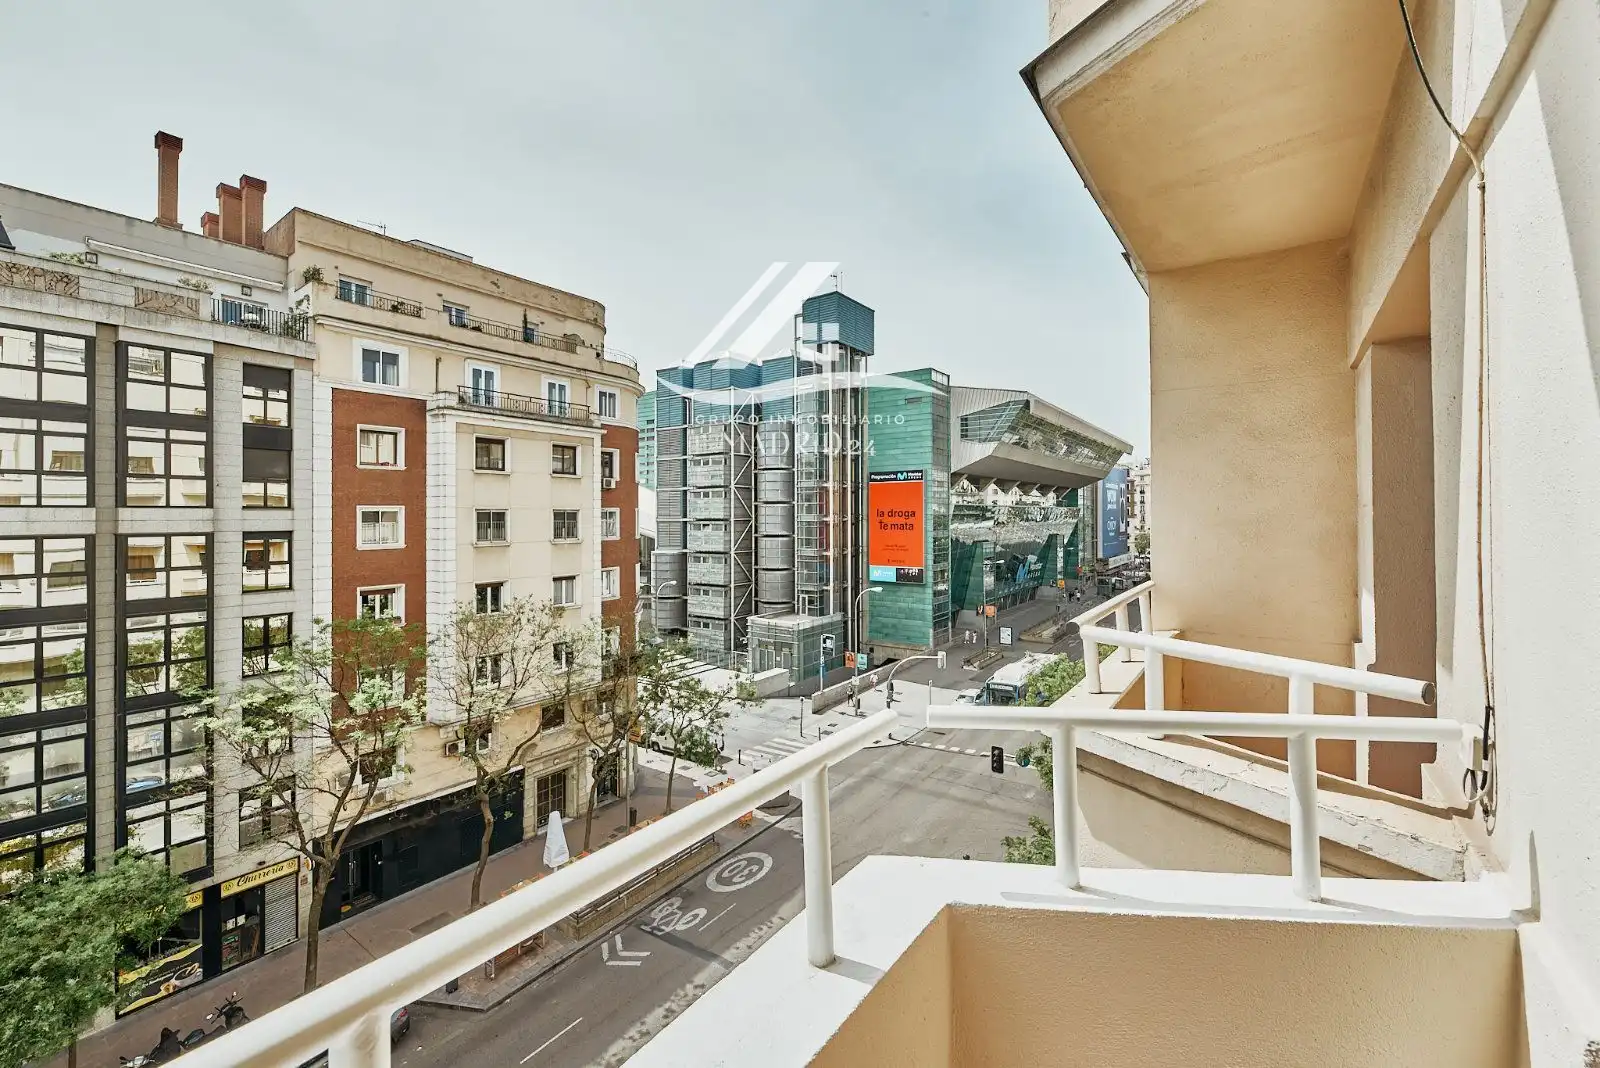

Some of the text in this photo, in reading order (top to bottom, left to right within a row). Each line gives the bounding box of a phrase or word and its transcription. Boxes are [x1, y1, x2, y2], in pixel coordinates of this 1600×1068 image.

[876, 508, 916, 520] la droga
[890, 522, 914, 531] mata
